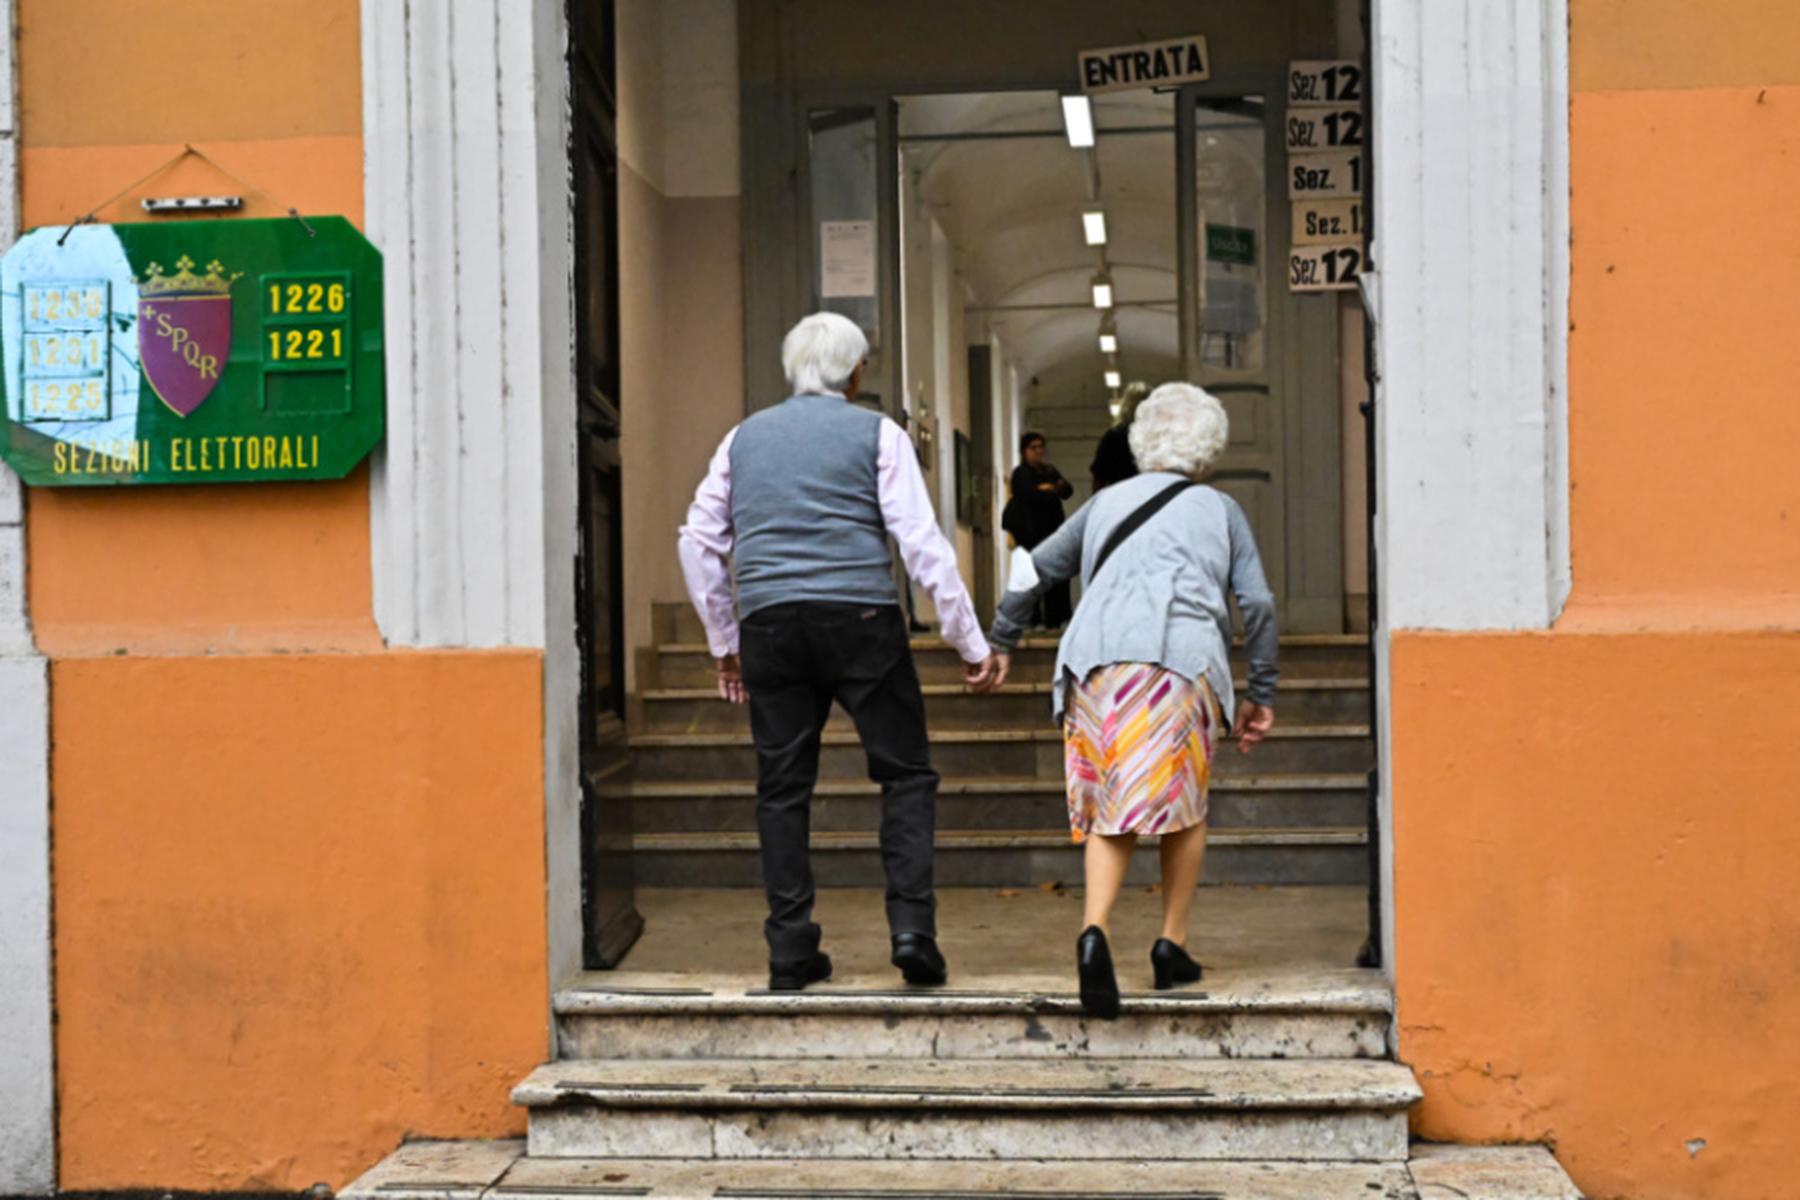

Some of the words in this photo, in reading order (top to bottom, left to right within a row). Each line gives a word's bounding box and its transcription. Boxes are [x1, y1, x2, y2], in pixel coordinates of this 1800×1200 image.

[1083, 42, 1204, 88] ENTRATA
[1290, 71, 1320, 101] Sez.
[1288, 117, 1319, 147] Sez.
[1294, 166, 1335, 190] Sez.
[1305, 212, 1347, 236] Sez.
[1350, 206, 1363, 235] 1
[1290, 255, 1320, 284] Sez.
[269, 284, 345, 313] 1226
[30, 336, 100, 367] 1231
[156, 314, 218, 379] SPQR
[269, 329, 342, 360] 1221
[30, 380, 102, 412] 1225
[54, 438, 150, 475] SEZIONI
[171, 434, 319, 472] ELETTORALI
